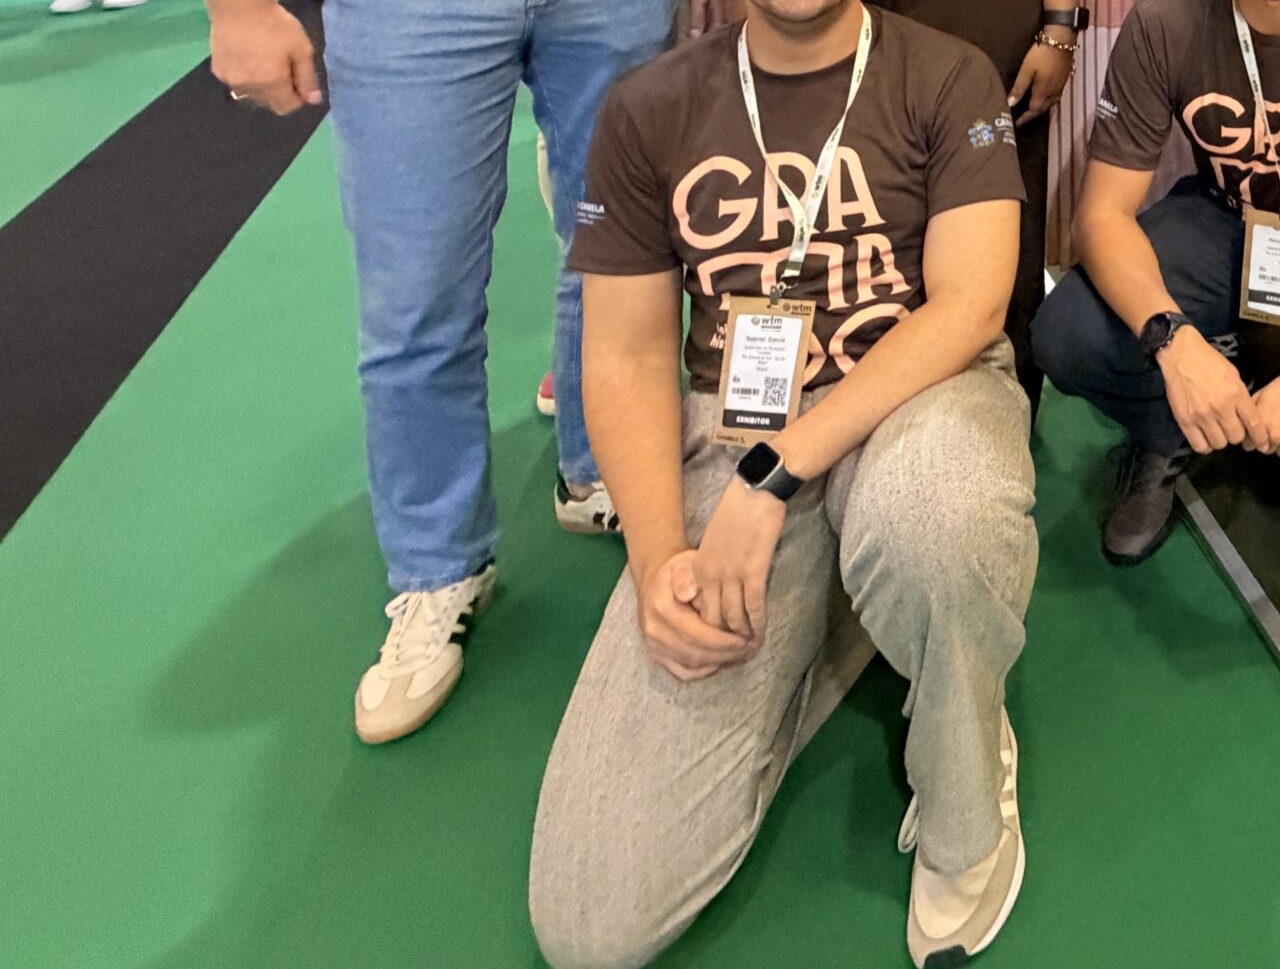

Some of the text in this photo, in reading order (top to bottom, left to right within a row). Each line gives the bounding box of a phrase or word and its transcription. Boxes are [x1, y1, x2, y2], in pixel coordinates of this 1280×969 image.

[672, 146, 887, 250] GRA
[698, 233, 911, 311] MA
[792, 303, 812, 312] wtm
[762, 316, 782, 325] wtm
[736, 415, 770, 425] EXHIBITOR
